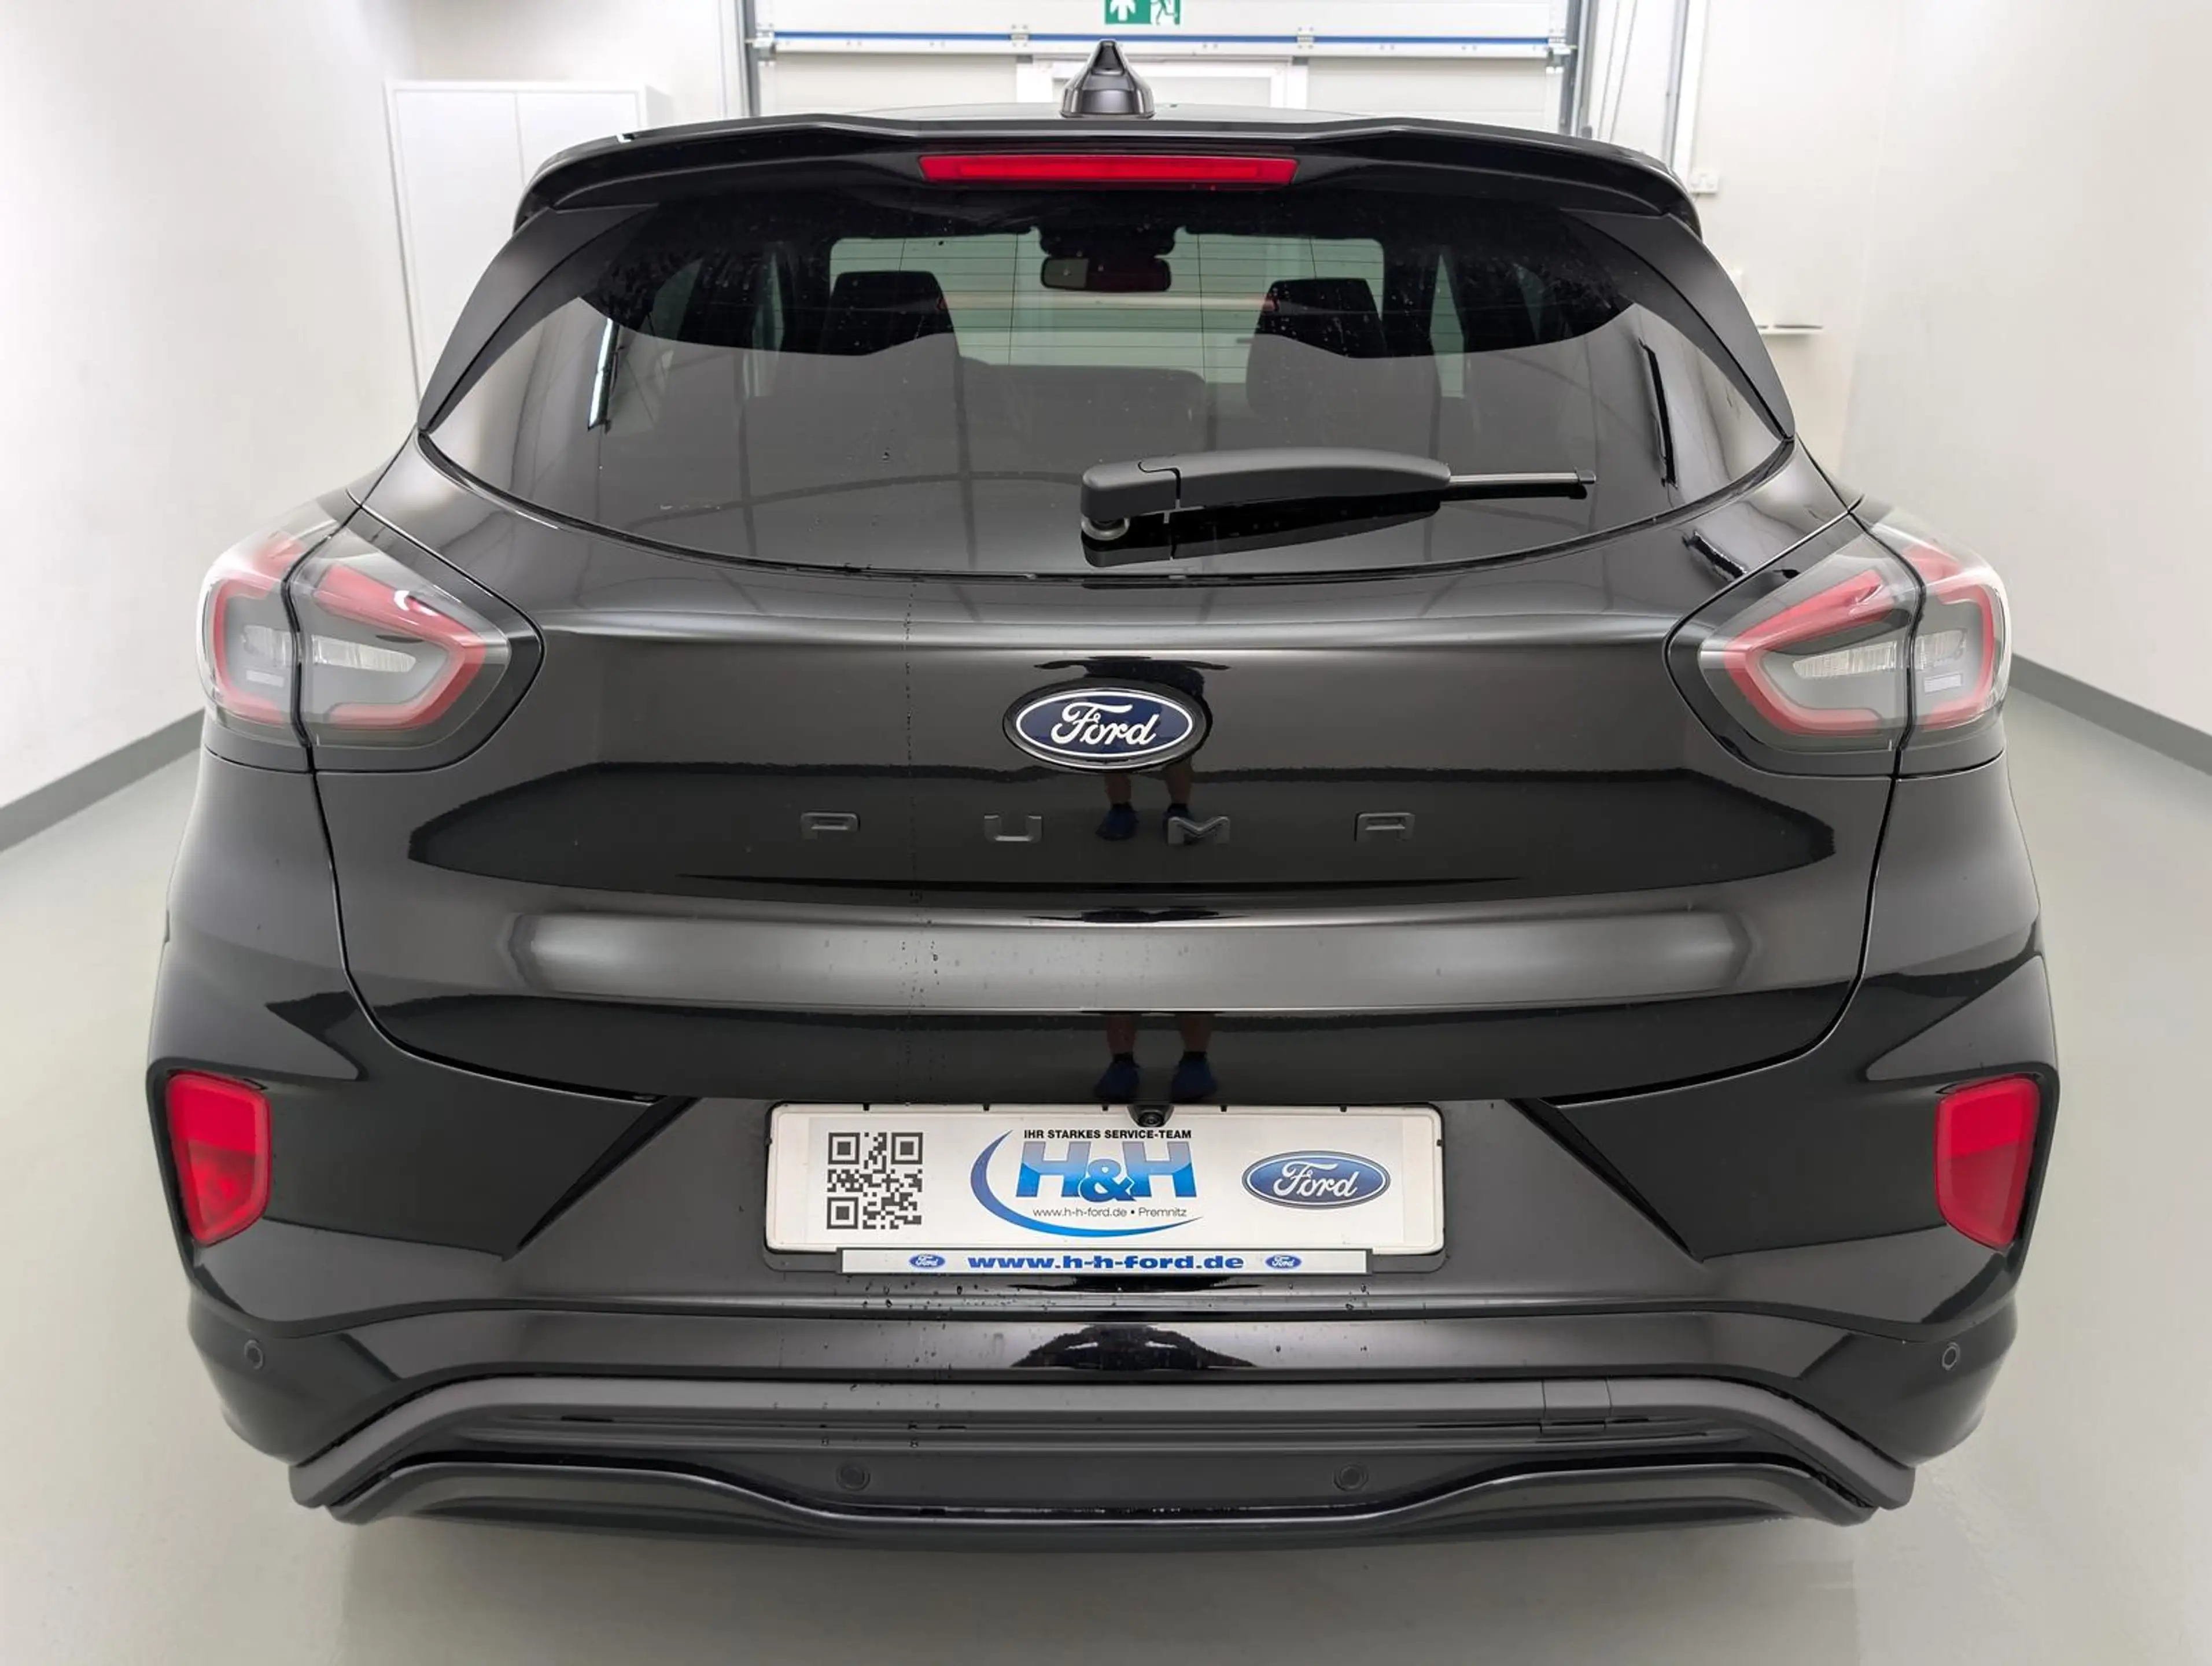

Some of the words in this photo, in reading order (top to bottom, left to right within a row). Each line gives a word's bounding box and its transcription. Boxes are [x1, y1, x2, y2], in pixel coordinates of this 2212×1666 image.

[1050, 702, 1160, 745] Ford
[800, 812, 1415, 845] PUMA
[1023, 1130, 1044, 1139] IHR
[1047, 1130, 1101, 1139] STARKES
[1104, 1130, 1192, 1139] SERVICE-TEAM
[1016, 1141, 1197, 1203] H&H
[1273, 1161, 1359, 1197] Ford
[1033, 1207, 1127, 1218] www.h-h-ford.de
[1138, 1207, 1187, 1217] Premnitz
[968, 1255, 1244, 1269] www.h-h-ford.de
[1271, 1255, 1295, 1267] Ford
